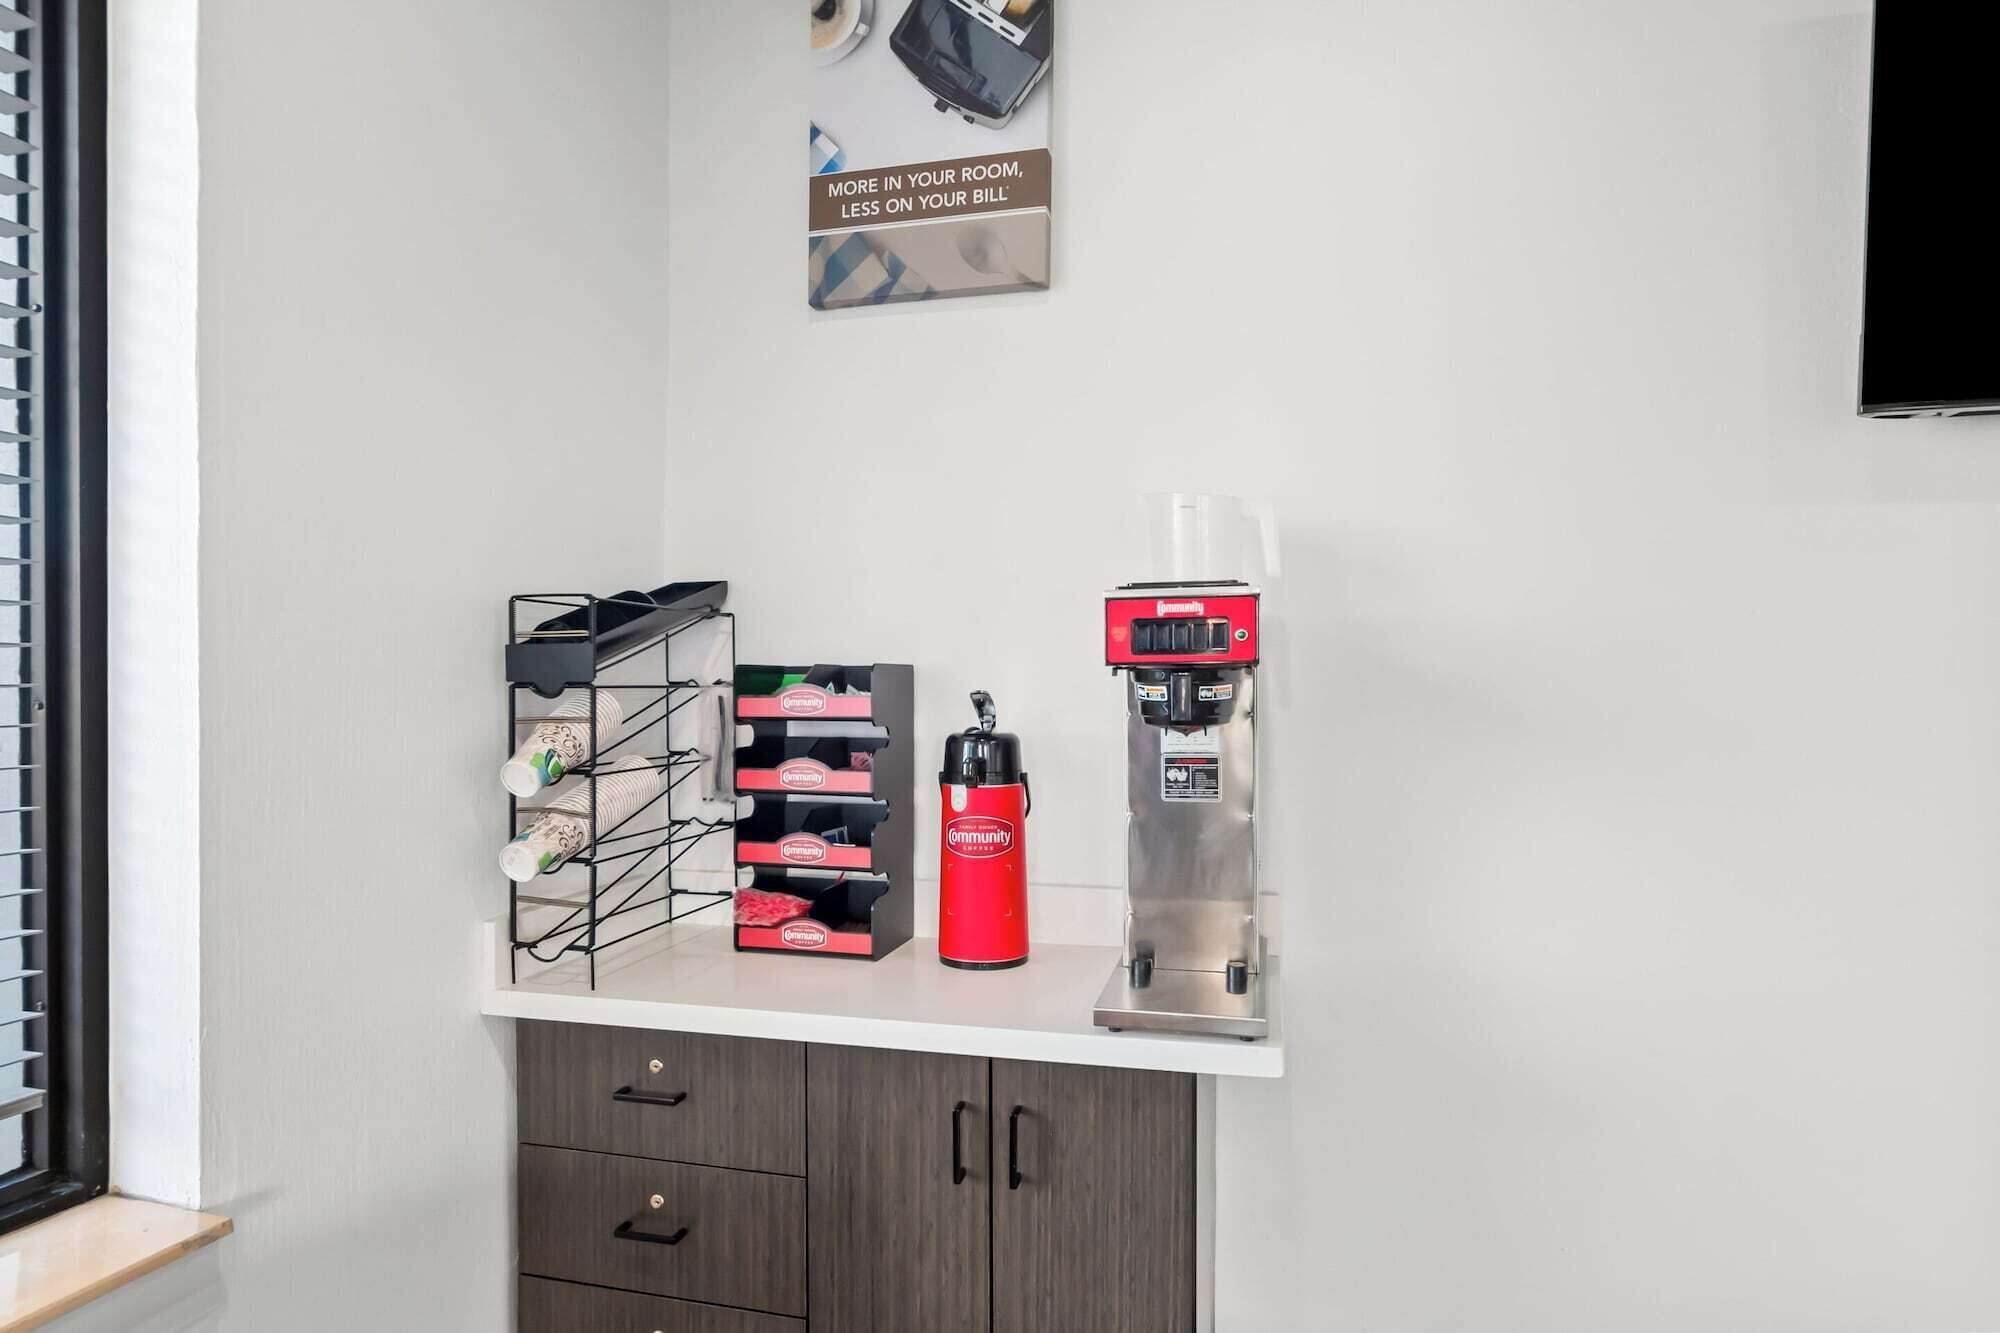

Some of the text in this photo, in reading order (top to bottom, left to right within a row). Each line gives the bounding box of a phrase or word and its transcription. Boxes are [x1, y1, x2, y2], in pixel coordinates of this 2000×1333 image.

[828, 161, 1023, 198] MORE IN YOUR ROOM,
[841, 187, 1008, 219] LESS ON YOUR BILL
[1156, 600, 1204, 617] Community
[783, 696, 823, 709] Community
[782, 770, 823, 784] Community
[948, 828, 1011, 846] Community
[783, 844, 824, 858] Community
[784, 930, 825, 943] Community
